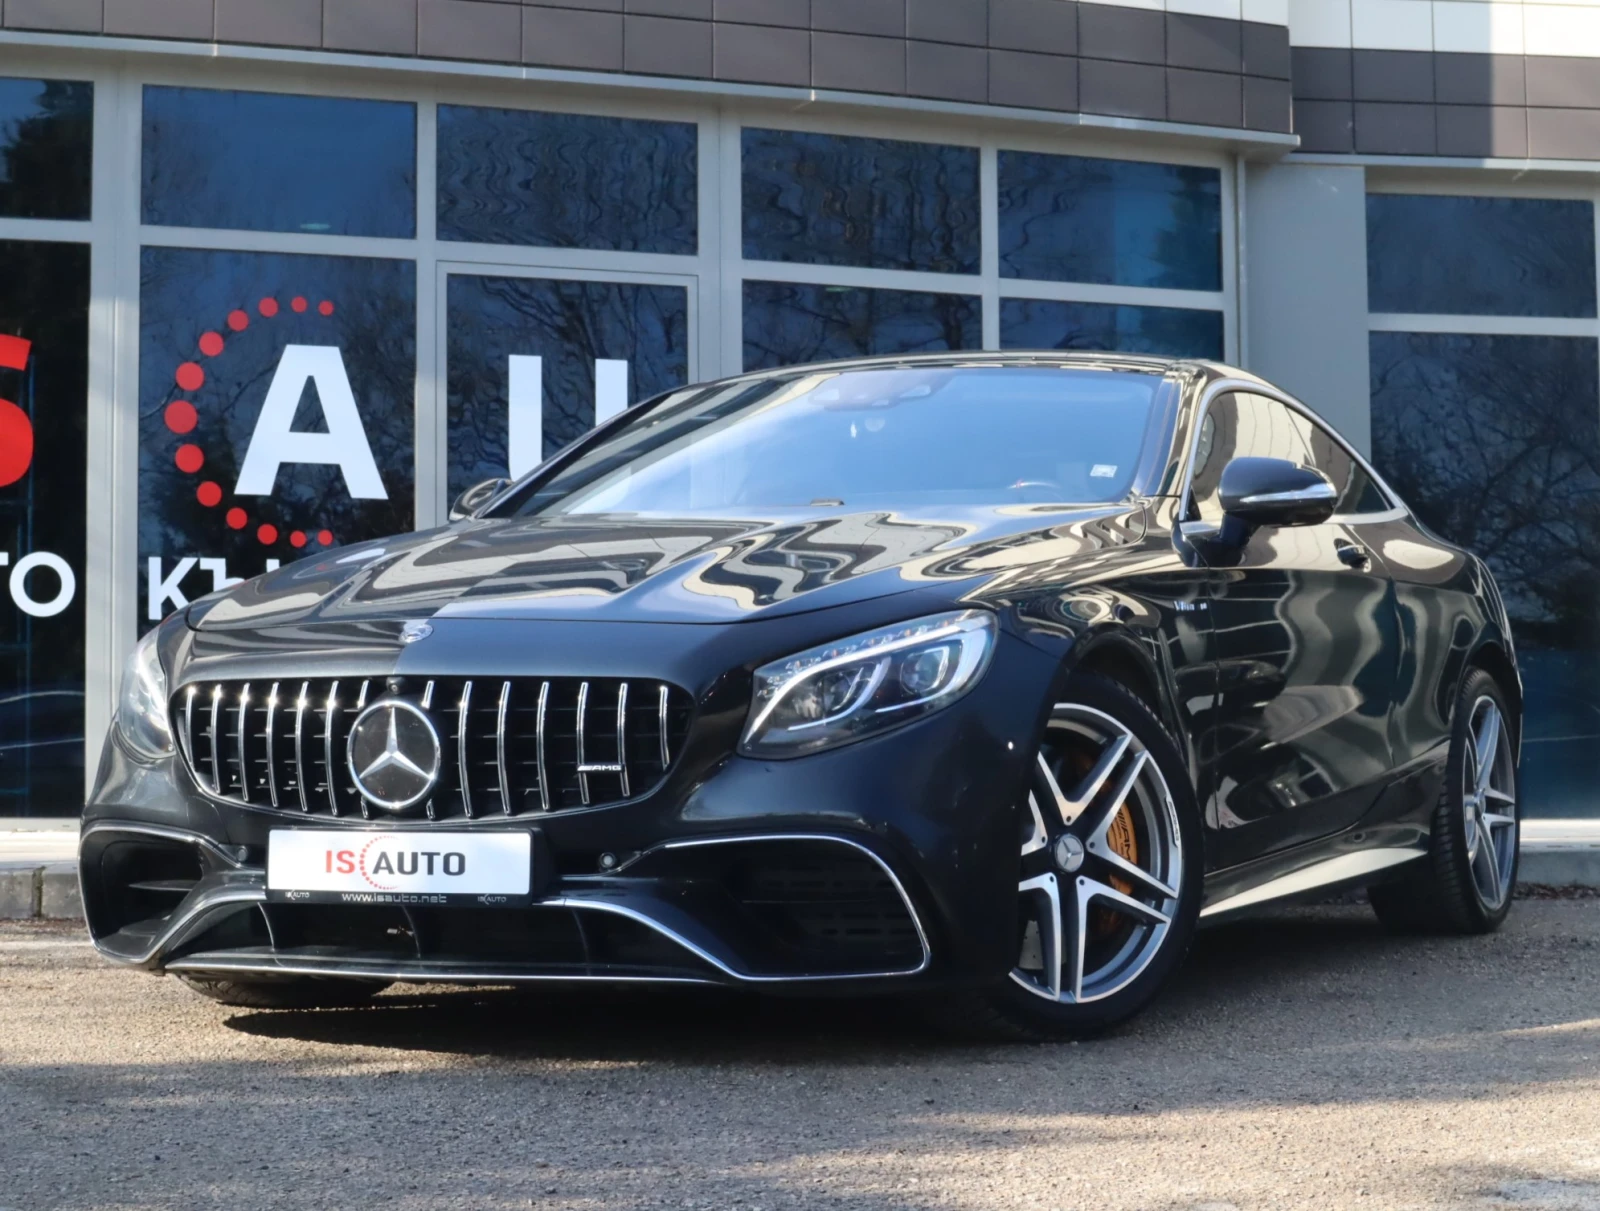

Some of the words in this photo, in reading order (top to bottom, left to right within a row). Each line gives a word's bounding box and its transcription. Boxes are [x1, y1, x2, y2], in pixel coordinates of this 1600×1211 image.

[326, 850, 355, 874] IS
[372, 851, 466, 876] AUTO
[341, 893, 447, 903] www.isauto.net
